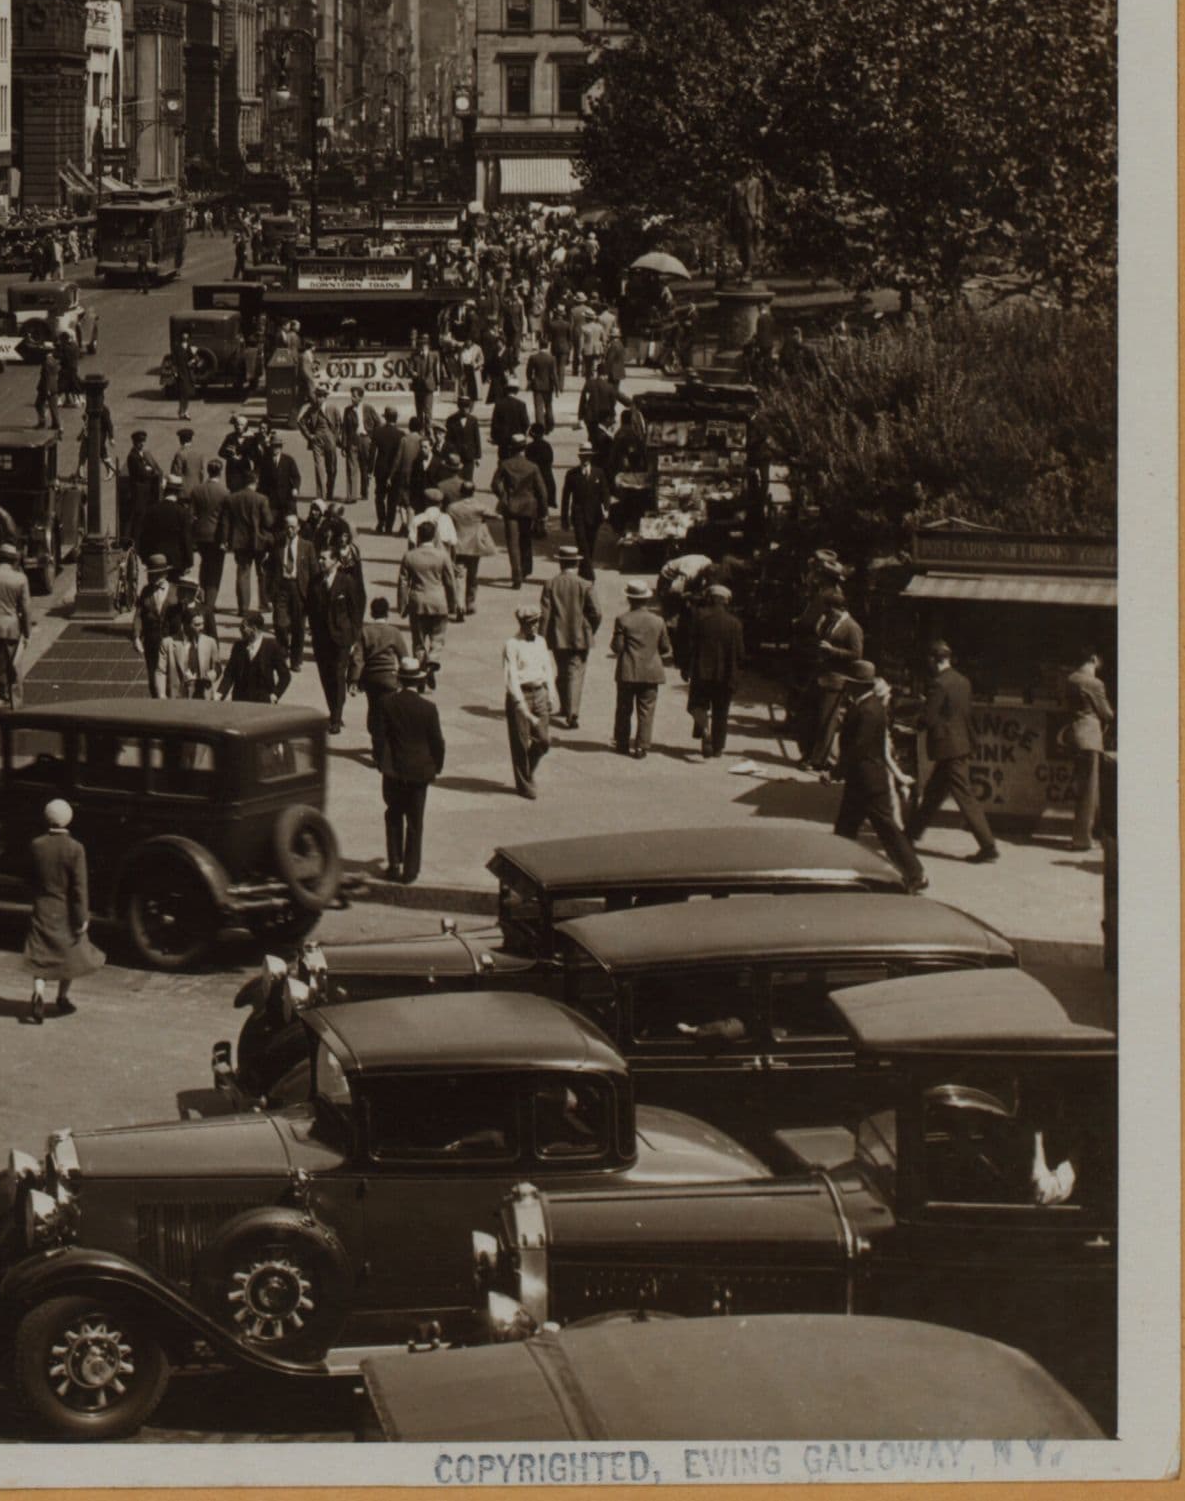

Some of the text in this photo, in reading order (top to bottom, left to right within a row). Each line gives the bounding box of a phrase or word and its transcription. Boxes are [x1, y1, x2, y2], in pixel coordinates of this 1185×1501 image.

[310, 281, 400, 289] DOWNTOWN TRAINS
[325, 362, 377, 379] COLD
[382, 359, 409, 379] SO
